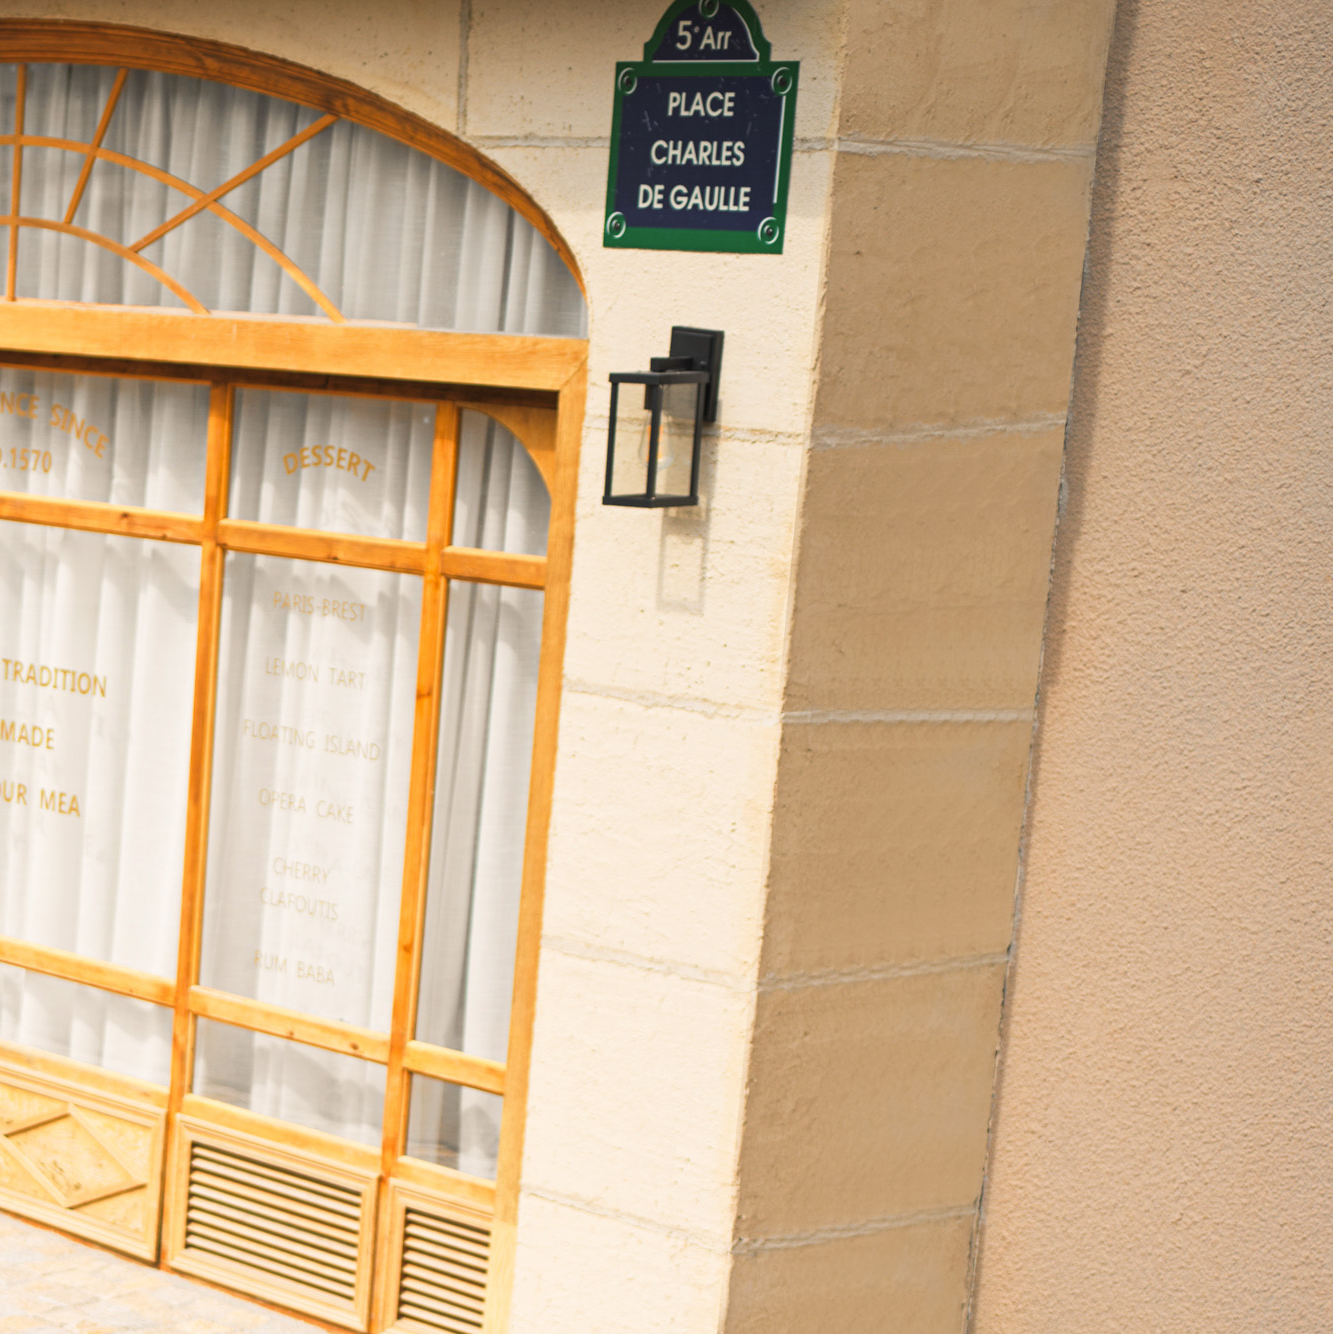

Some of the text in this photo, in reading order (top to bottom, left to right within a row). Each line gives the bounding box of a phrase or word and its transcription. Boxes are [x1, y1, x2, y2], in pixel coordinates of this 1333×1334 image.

[699, 25, 732, 50] Arr
[668, 91, 735, 117] PLACE
[651, 140, 745, 167] CHARLES
[638, 184, 751, 211] DE GAULLE
[49, 403, 110, 459] SINCE
[282, 445, 376, 482] DESSERT
[273, 591, 365, 622] PARIS-BREST
[2, 658, 107, 698] TRADITION
[265, 656, 365, 691] LEMON TART
[244, 718, 381, 762] FLOATING ISLAND
[40, 788, 81, 818] MEA
[259, 787, 354, 825] OPERA CAKE
[273, 856, 330, 886] CHERRY
[258, 886, 339, 922] CLAFOUTIS
[254, 949, 336, 986] RUM BABA
